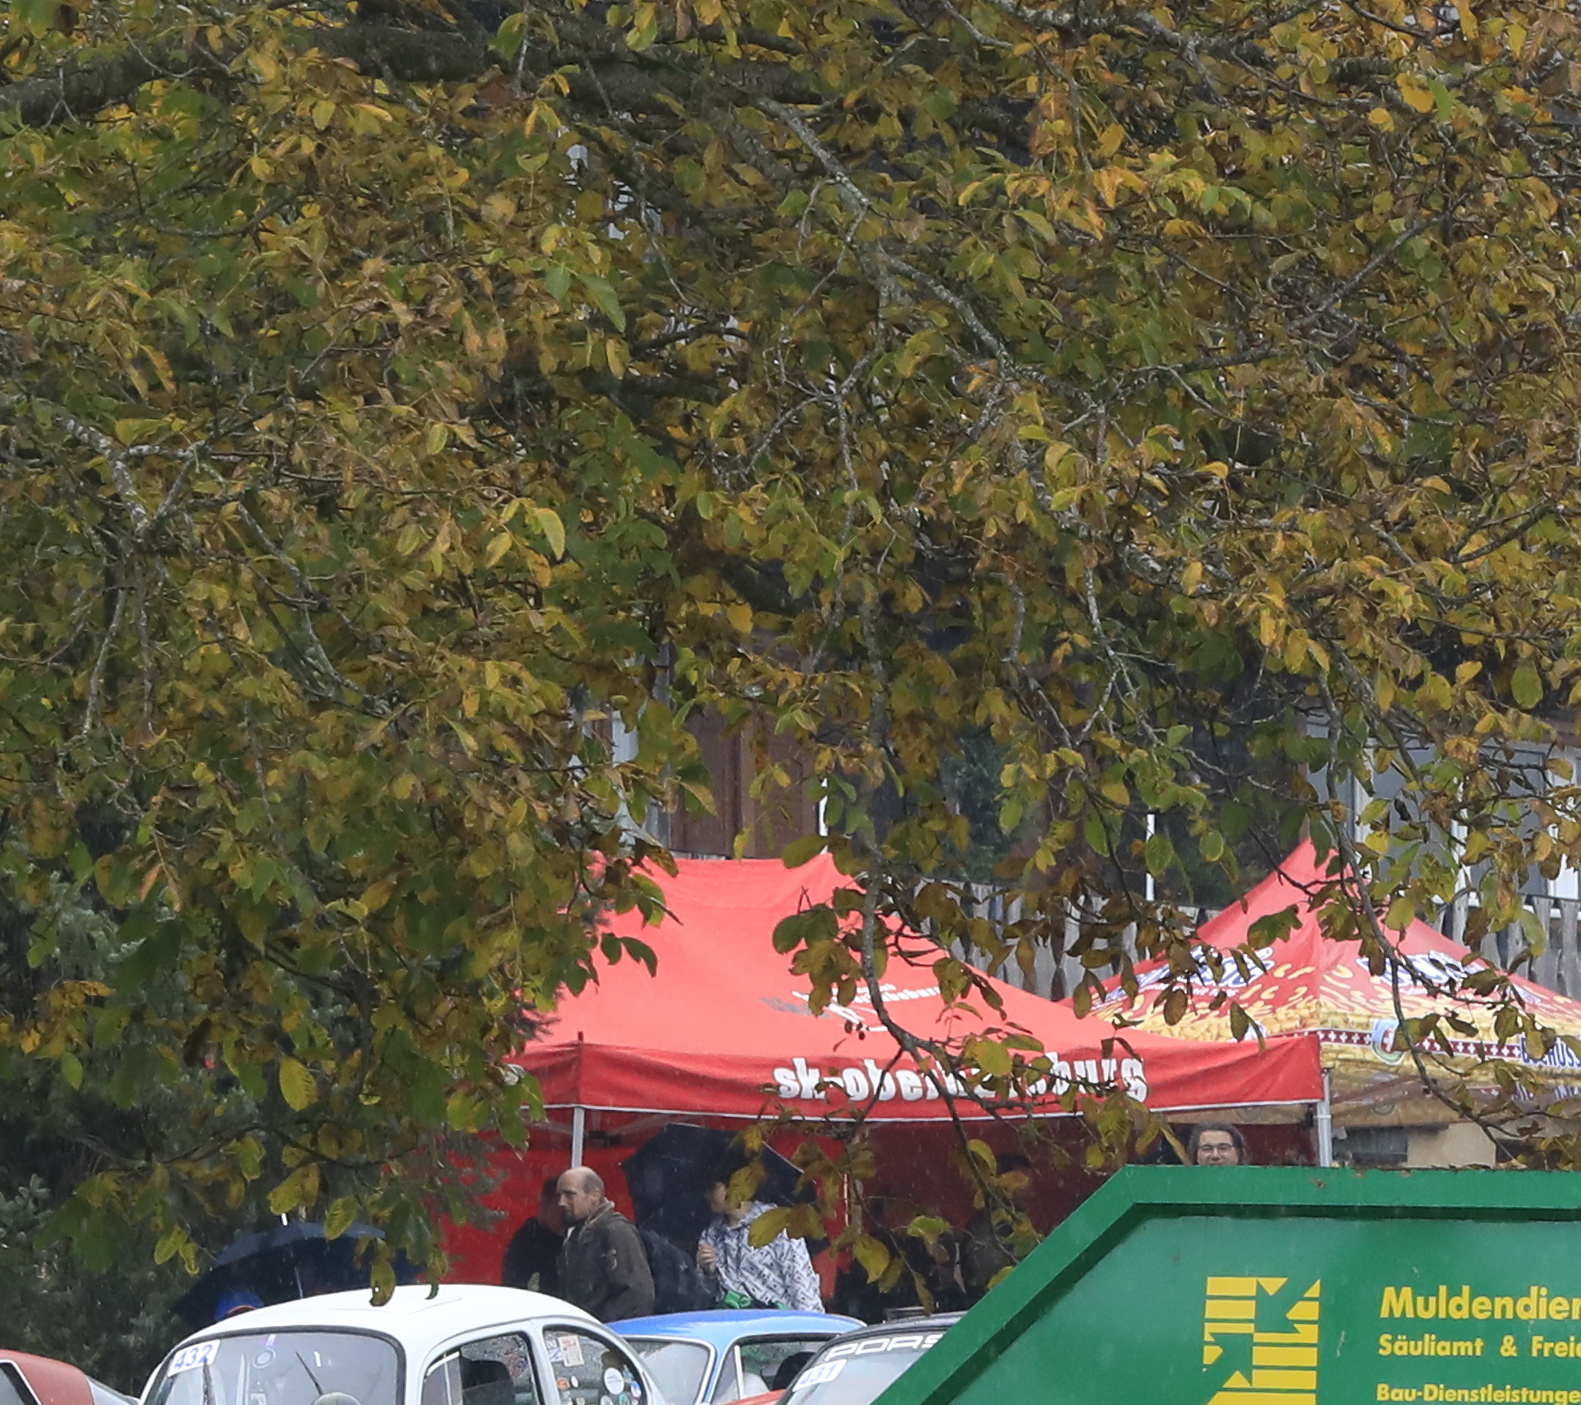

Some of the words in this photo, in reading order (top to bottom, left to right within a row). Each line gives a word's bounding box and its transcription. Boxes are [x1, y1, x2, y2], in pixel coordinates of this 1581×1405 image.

[173, 1344, 213, 1369] 432
[1378, 1332, 1484, 1357] Säuliamt
[1499, 1336, 1518, 1357] &
